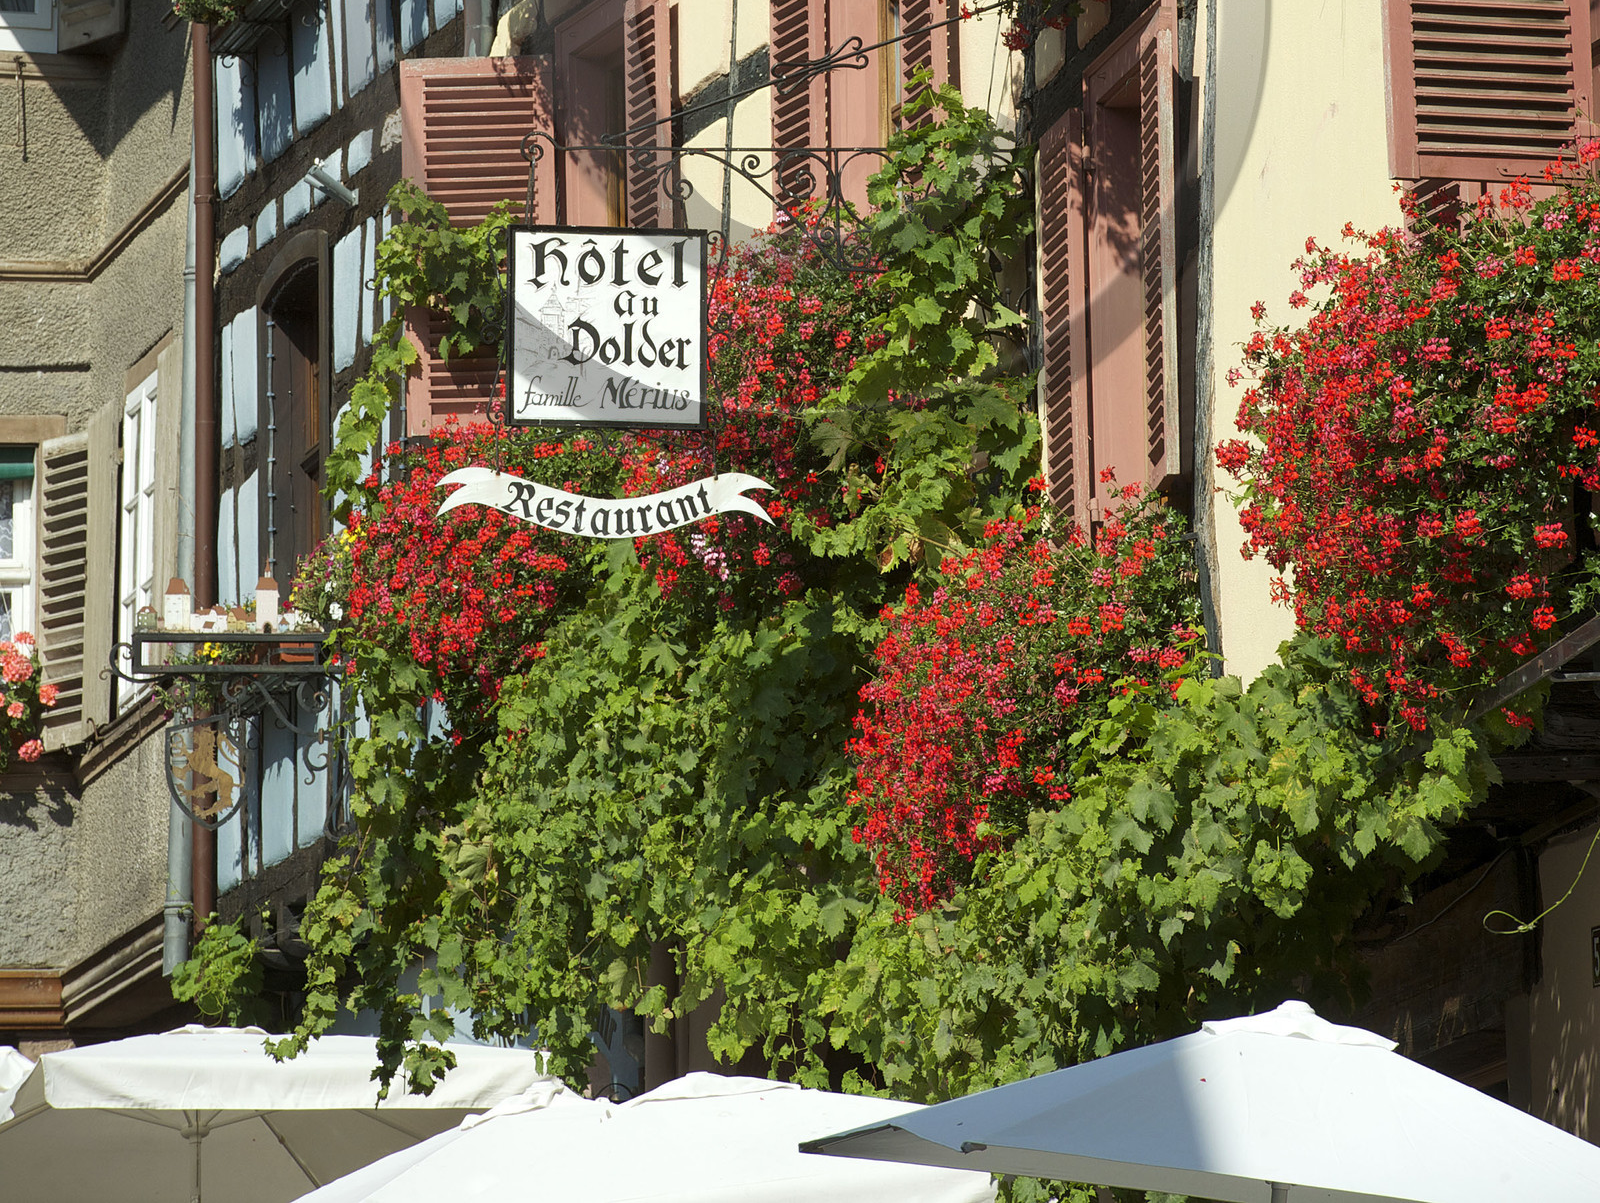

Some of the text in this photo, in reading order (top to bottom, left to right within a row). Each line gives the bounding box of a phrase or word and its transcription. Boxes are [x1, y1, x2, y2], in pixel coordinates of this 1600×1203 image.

[558, 316, 692, 371] Dolder
[516, 375, 594, 414] famille
[501, 481, 713, 536] Restaurant
